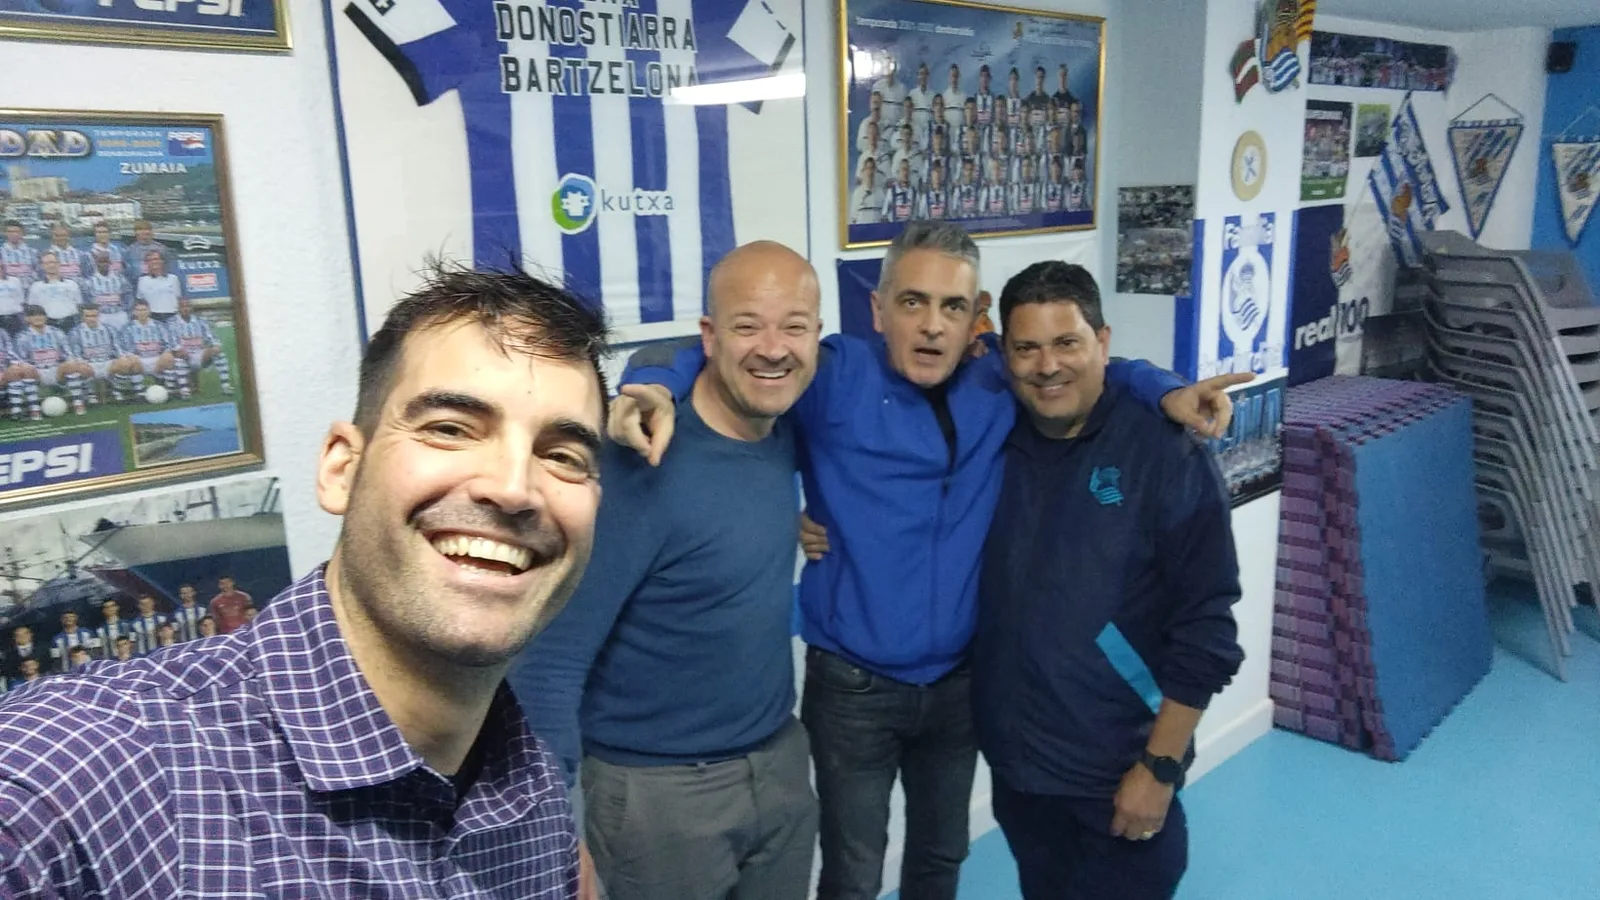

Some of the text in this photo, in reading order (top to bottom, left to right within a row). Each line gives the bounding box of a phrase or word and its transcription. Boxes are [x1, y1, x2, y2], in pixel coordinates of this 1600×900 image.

[98, 0, 243, 17] PSI
[496, 3, 697, 51] DONOSTIARRA
[502, 56, 698, 96] BARTZELONA
[601, 189, 674, 212] kutxa
